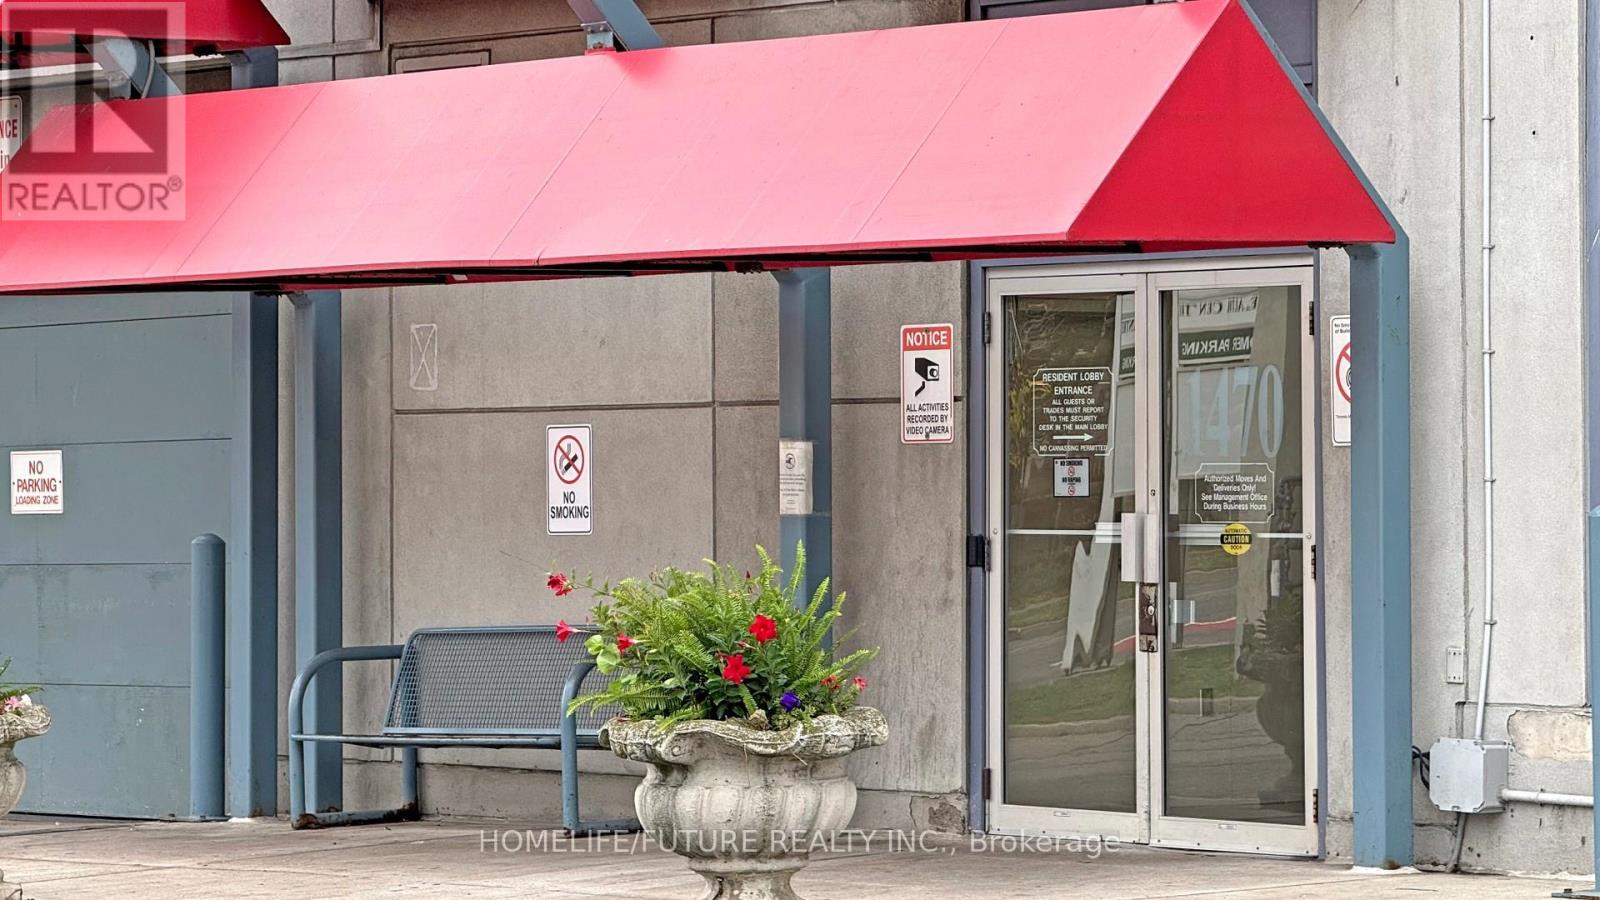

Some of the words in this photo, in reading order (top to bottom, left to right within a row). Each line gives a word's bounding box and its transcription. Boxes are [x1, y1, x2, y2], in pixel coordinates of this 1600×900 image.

[906, 331, 947, 346] NOTICE
[1043, 373, 1077, 381] RESIDENT
[1081, 372, 1104, 380] LOBBY
[1055, 386, 1092, 395] ENTRANCE
[906, 404, 917, 412] ALL
[918, 403, 948, 411] ACTIVITIES
[1186, 365, 1284, 458] 1470
[907, 415, 939, 423] RECORDED
[925, 426, 949, 434] CAMERA
[29, 460, 43, 474] NO
[17, 478, 57, 492] PARKING
[1242, 484, 1256, 492] Only!
[16, 496, 40, 504] LOADING
[43, 496, 58, 504] ZONE
[563, 491, 575, 503] NO
[1214, 494, 1248, 502] Management
[1204, 503, 1221, 511] During
[550, 506, 589, 519] SMOKING
